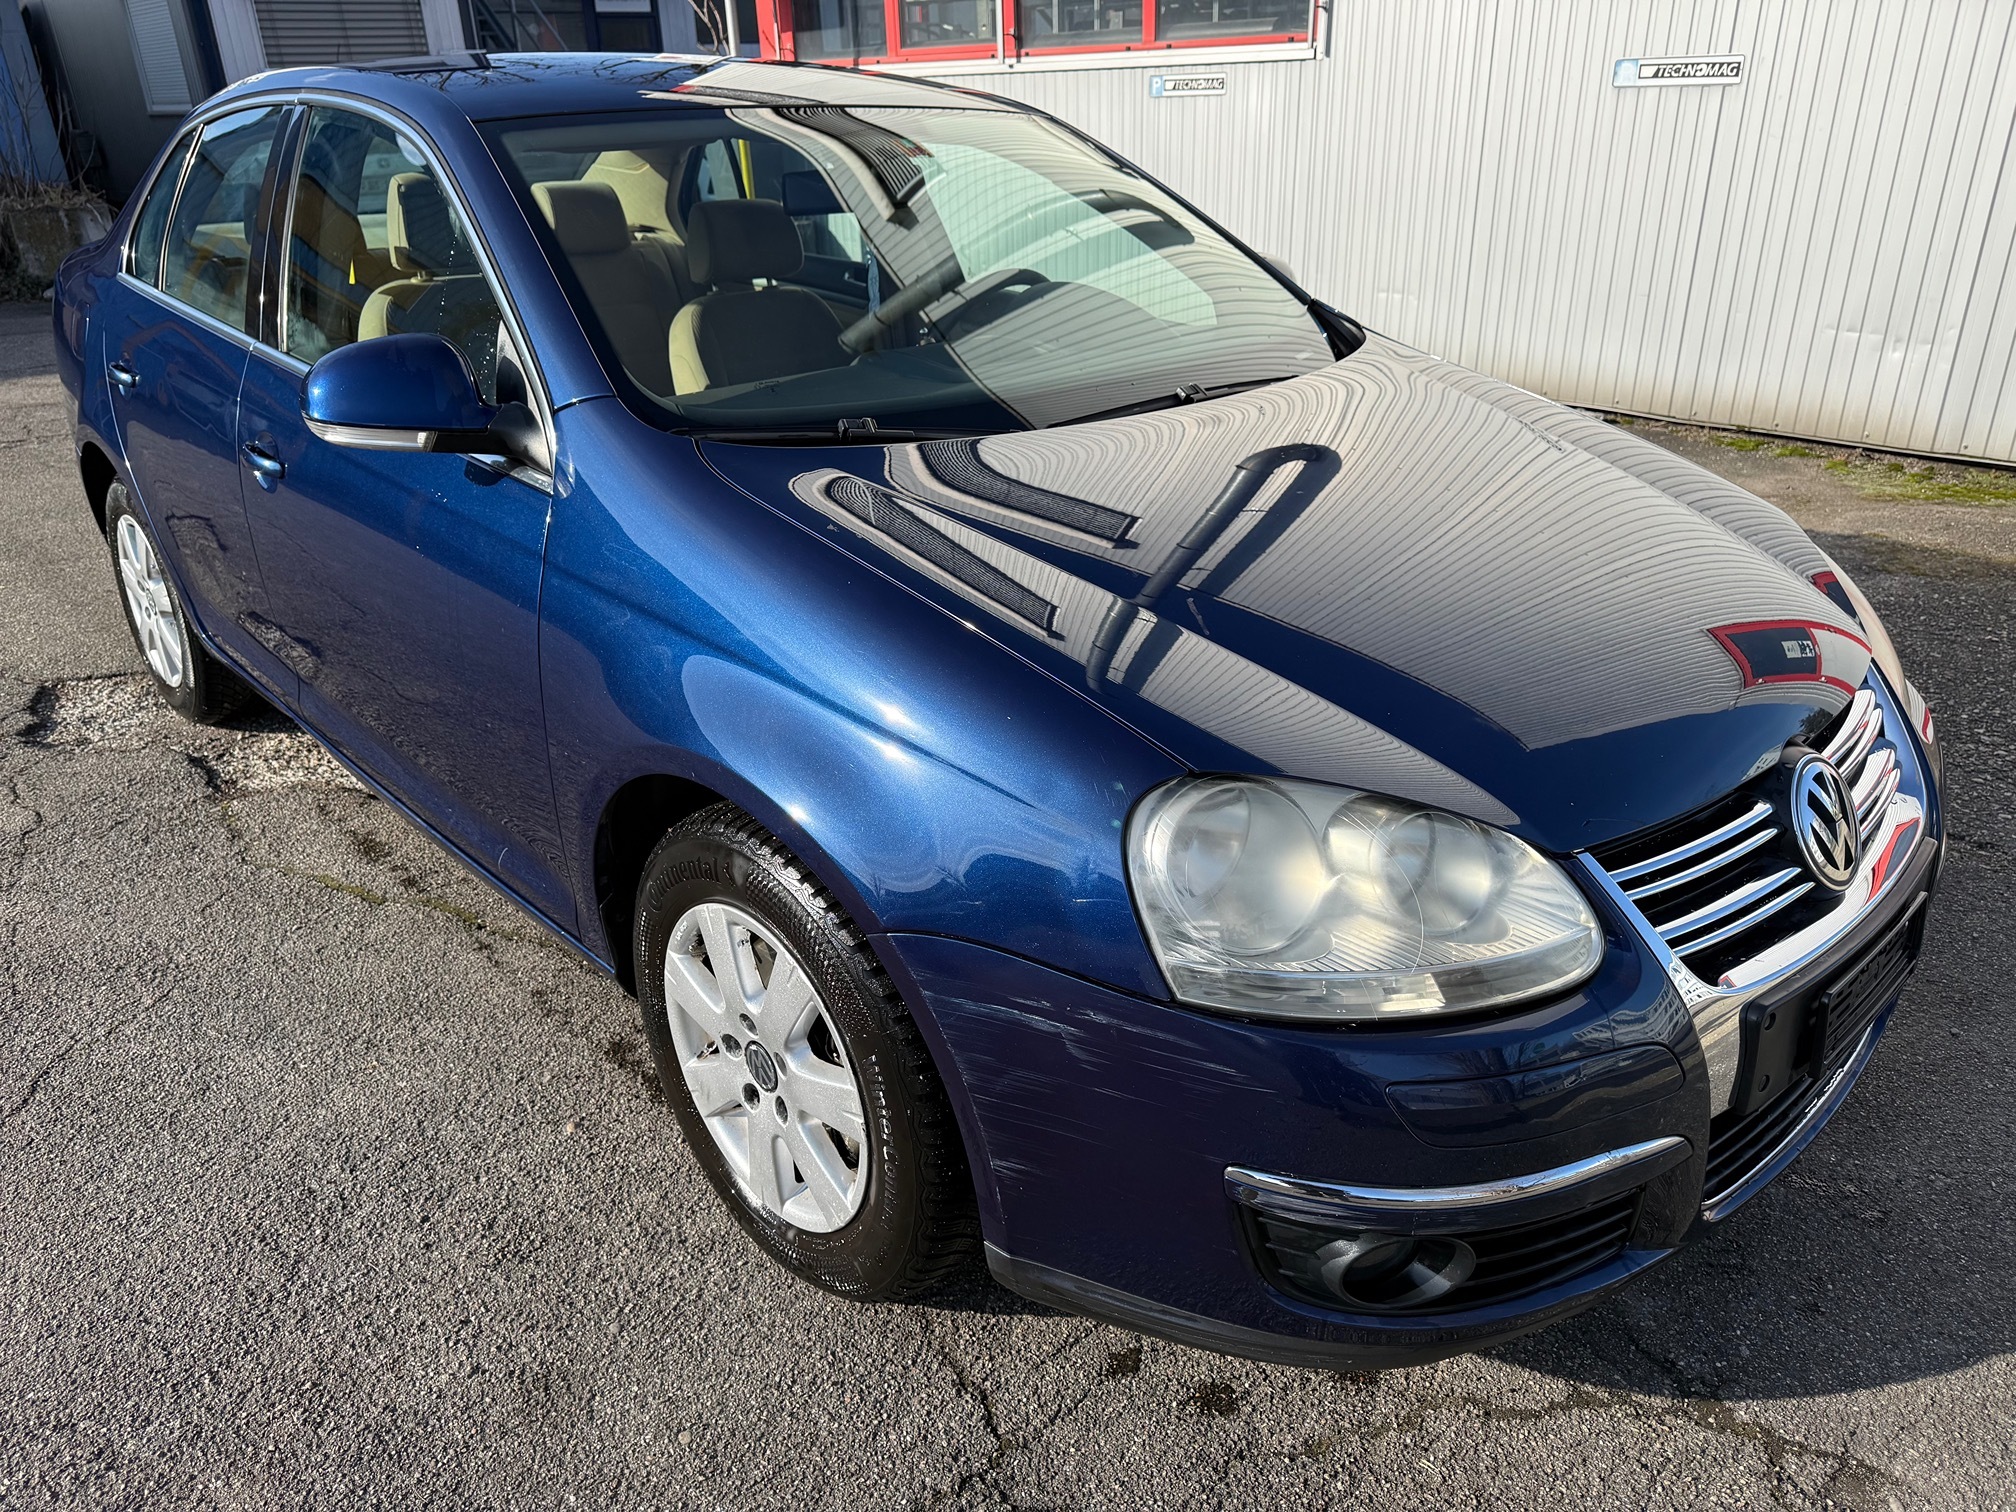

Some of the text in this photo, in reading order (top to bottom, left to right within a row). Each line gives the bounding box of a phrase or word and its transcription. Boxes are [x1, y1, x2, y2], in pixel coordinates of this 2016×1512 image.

[1657, 63, 1738, 77] TECHNOMAG
[1153, 78, 1161, 95] P
[648, 856, 722, 913] Continental
